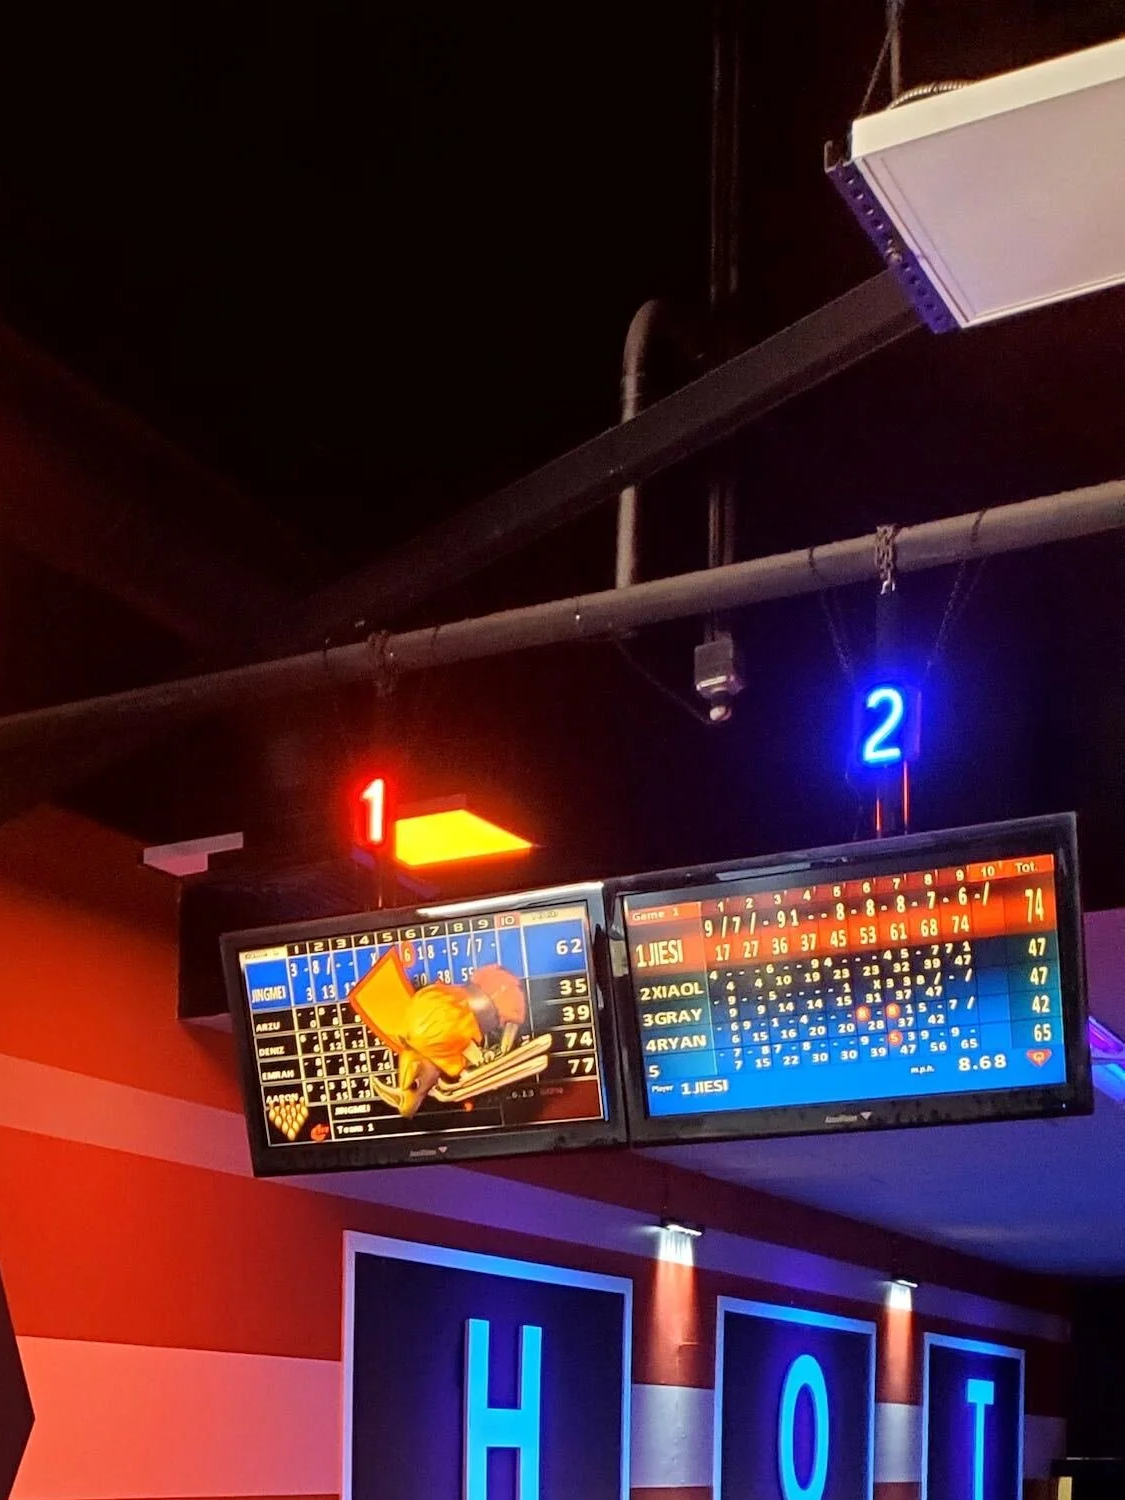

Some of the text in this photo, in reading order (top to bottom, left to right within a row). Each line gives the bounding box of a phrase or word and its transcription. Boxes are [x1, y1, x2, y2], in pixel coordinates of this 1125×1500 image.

[863, 687, 904, 763] 2
[361, 778, 384, 842] 1
[718, 901, 724, 912] 1
[746, 898, 754, 909] 2
[774, 894, 782, 905] 3
[803, 890, 811, 901] 4
[833, 886, 841, 897] 5
[863, 882, 871, 893] 6
[893, 878, 900, 890] 7
[924, 874, 932, 885] 8
[956, 869, 964, 881] 9
[981, 866, 995, 878] 10
[633, 911, 665, 921] Game
[1025, 888, 1044, 923] 74
[295, 916, 514, 954] 1 2 3 4 5 6 7 8 9 10
[556, 938, 583, 955] 62
[716, 944, 730, 961] 17
[743, 941, 759, 958] 27
[772, 937, 788, 955] 36
[801, 933, 816, 951] 37
[830, 930, 847, 947] 45
[860, 926, 876, 944] 53
[890, 922, 907, 940] 61
[921, 918, 938, 937] 68
[952, 915, 969, 933] 74
[1029, 937, 1046, 956] 47
[726, 981, 735, 991] 4
[755, 978, 763, 988] 4
[776, 975, 792, 985] 10
[805, 972, 820, 982] 19
[833, 969, 850, 979] 23
[863, 965, 879, 976] 23
[893, 962, 910, 973] 32
[924, 958, 941, 969] 39
[954, 955, 971, 965] 47
[1030, 967, 1048, 986] 47
[252, 985, 286, 1003] JINGMEI
[306, 987, 313, 1001] 3
[322, 984, 335, 999] 13
[560, 978, 587, 995] 35
[562, 1005, 590, 1022] 39
[729, 1008, 738, 1017] 9
[757, 1005, 765, 1014] 9
[778, 1002, 794, 1012] 14
[807, 999, 823, 1009] 14
[836, 996, 852, 1006] 15
[866, 993, 882, 1003] 31
[896, 989, 912, 1000] 37
[926, 986, 943, 997] 47
[731, 1022, 739, 1031] 6
[743, 1021, 751, 1030] 9
[771, 1018, 779, 1027] 1
[800, 1015, 808, 1024] 4
[1032, 995, 1050, 1013] 42
[256, 1022, 280, 1032] ARZU
[732, 1035, 739, 1043] 6
[753, 1032, 768, 1041] 15
[781, 1029, 797, 1039] 16
[809, 1026, 826, 1036] 20
[838, 1023, 855, 1033] 20
[868, 1020, 884, 1030] 28
[898, 1017, 914, 1027] 37
[928, 1014, 945, 1024] 42
[259, 1046, 285, 1057] DENIZ
[565, 1031, 593, 1048] 74
[734, 1048, 742, 1057] 7
[762, 1045, 770, 1054] 8
[774, 1044, 782, 1053] 7
[802, 1041, 811, 1050] 8
[861, 1036, 869, 1045] 9
[1034, 1023, 1052, 1042] 65
[568, 1057, 595, 1075] 77
[649, 1039, 978, 1078] 5 7 15 22 30 30 39 47 56 65
[262, 1070, 295, 1081] EMRAH
[651, 1084, 674, 1093] Player
[958, 1053, 1006, 1072] 8.68
[337, 1125, 364, 1134] Team
